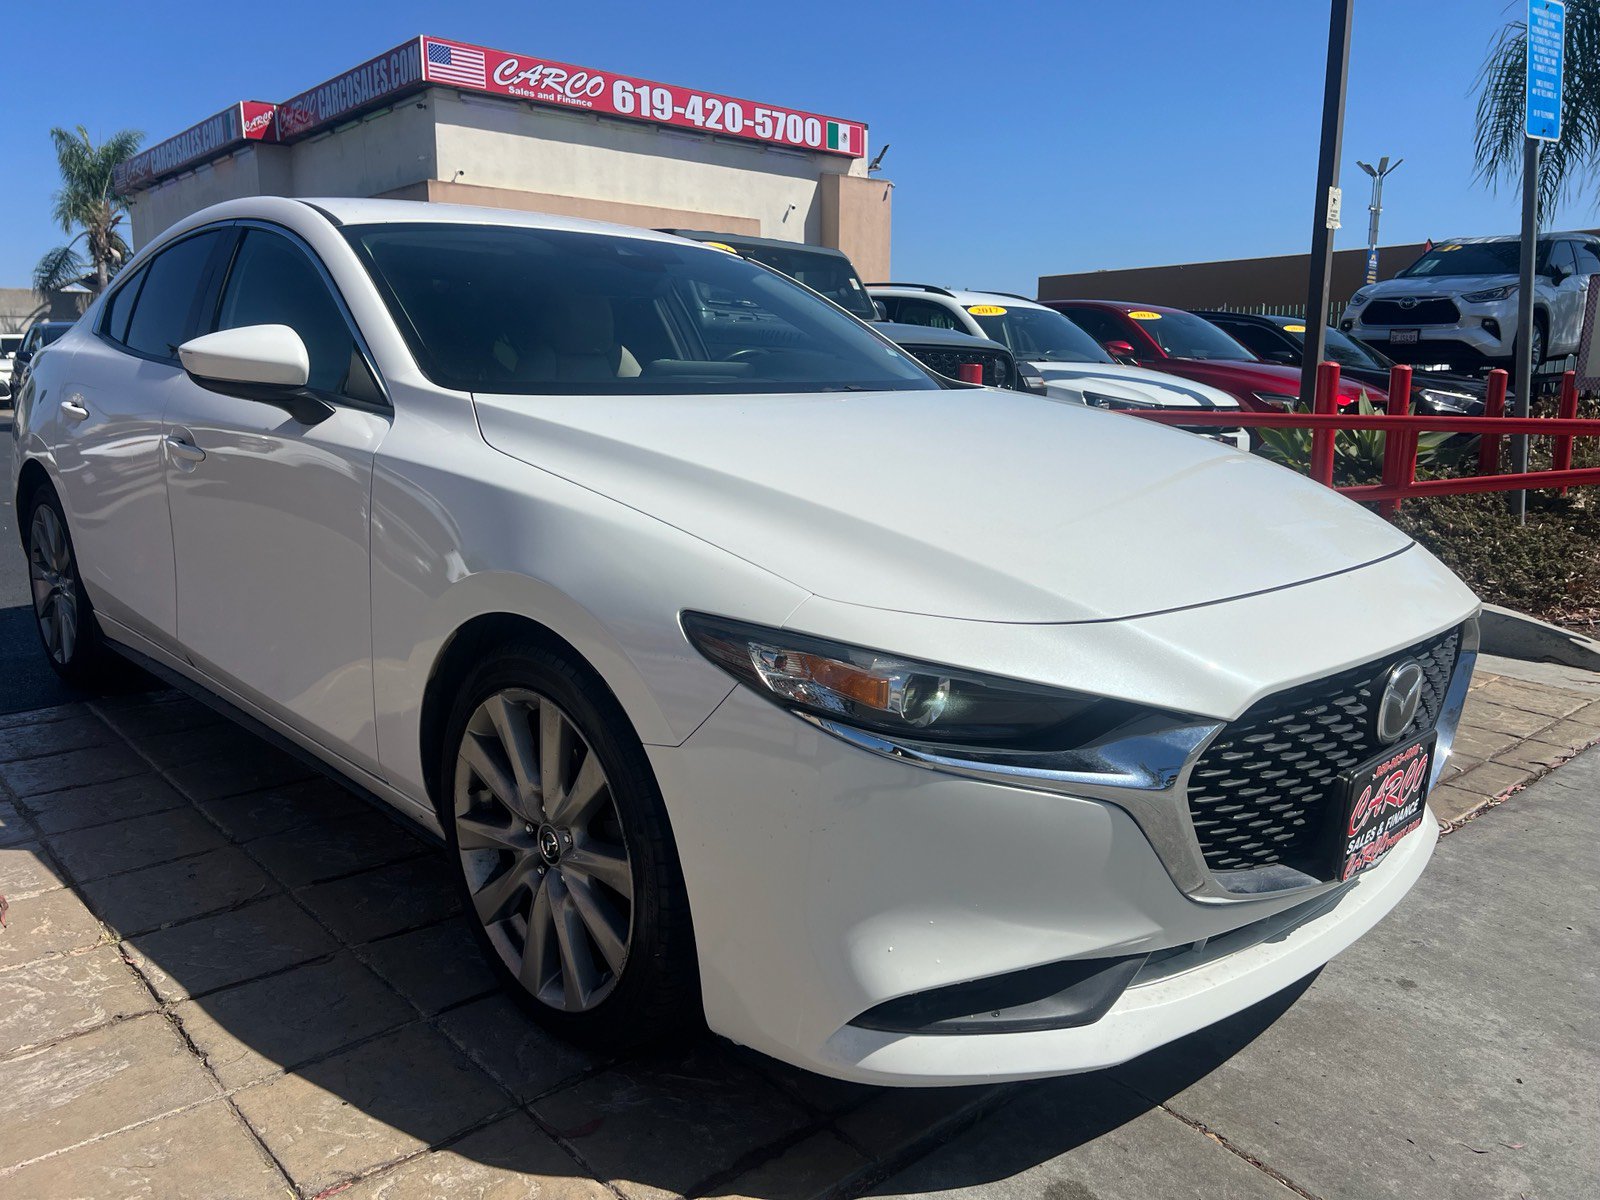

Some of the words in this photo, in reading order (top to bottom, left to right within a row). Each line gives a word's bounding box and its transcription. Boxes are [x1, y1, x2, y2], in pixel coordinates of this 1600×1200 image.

[317, 43, 421, 121] CARCOSALES.COM
[493, 58, 605, 98] CARCO
[508, 86, 535, 98] Sales
[537, 90, 555, 102] and
[557, 94, 593, 107] Finance
[244, 110, 274, 132] CARCO
[612, 79, 822, 147] 619-420-5700
[150, 116, 224, 175] CARCOSALES.COM
[1348, 754, 1428, 837] CARCO
[1346, 827, 1377, 855] SALES
[1377, 822, 1383, 836] &
[1384, 798, 1420, 831] FINANCE
